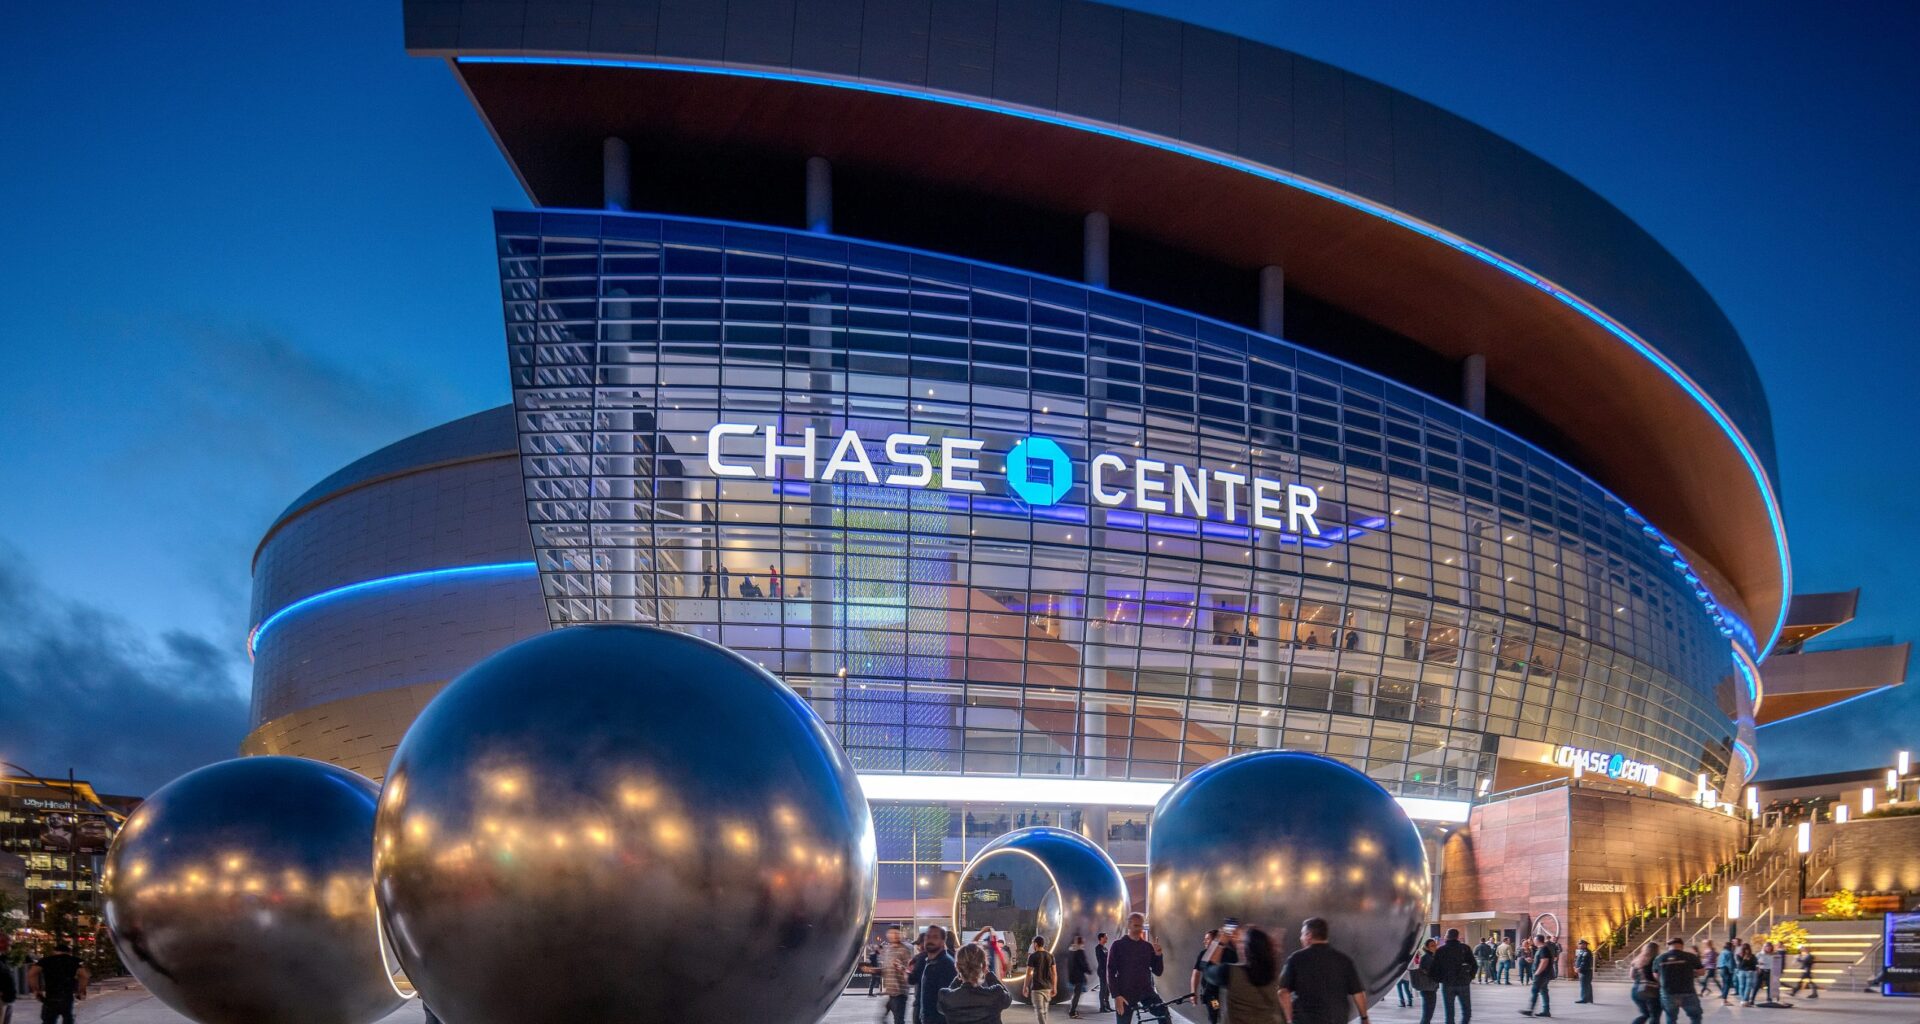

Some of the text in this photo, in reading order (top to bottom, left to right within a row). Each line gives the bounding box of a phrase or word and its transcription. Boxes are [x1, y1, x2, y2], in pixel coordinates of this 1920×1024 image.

[707, 423, 1321, 537] CHASE CENTER
[1558, 746, 1659, 786] CHASE CENT
[1583, 883, 1614, 893] WARRIORS
[1615, 884, 1627, 893] WAY
